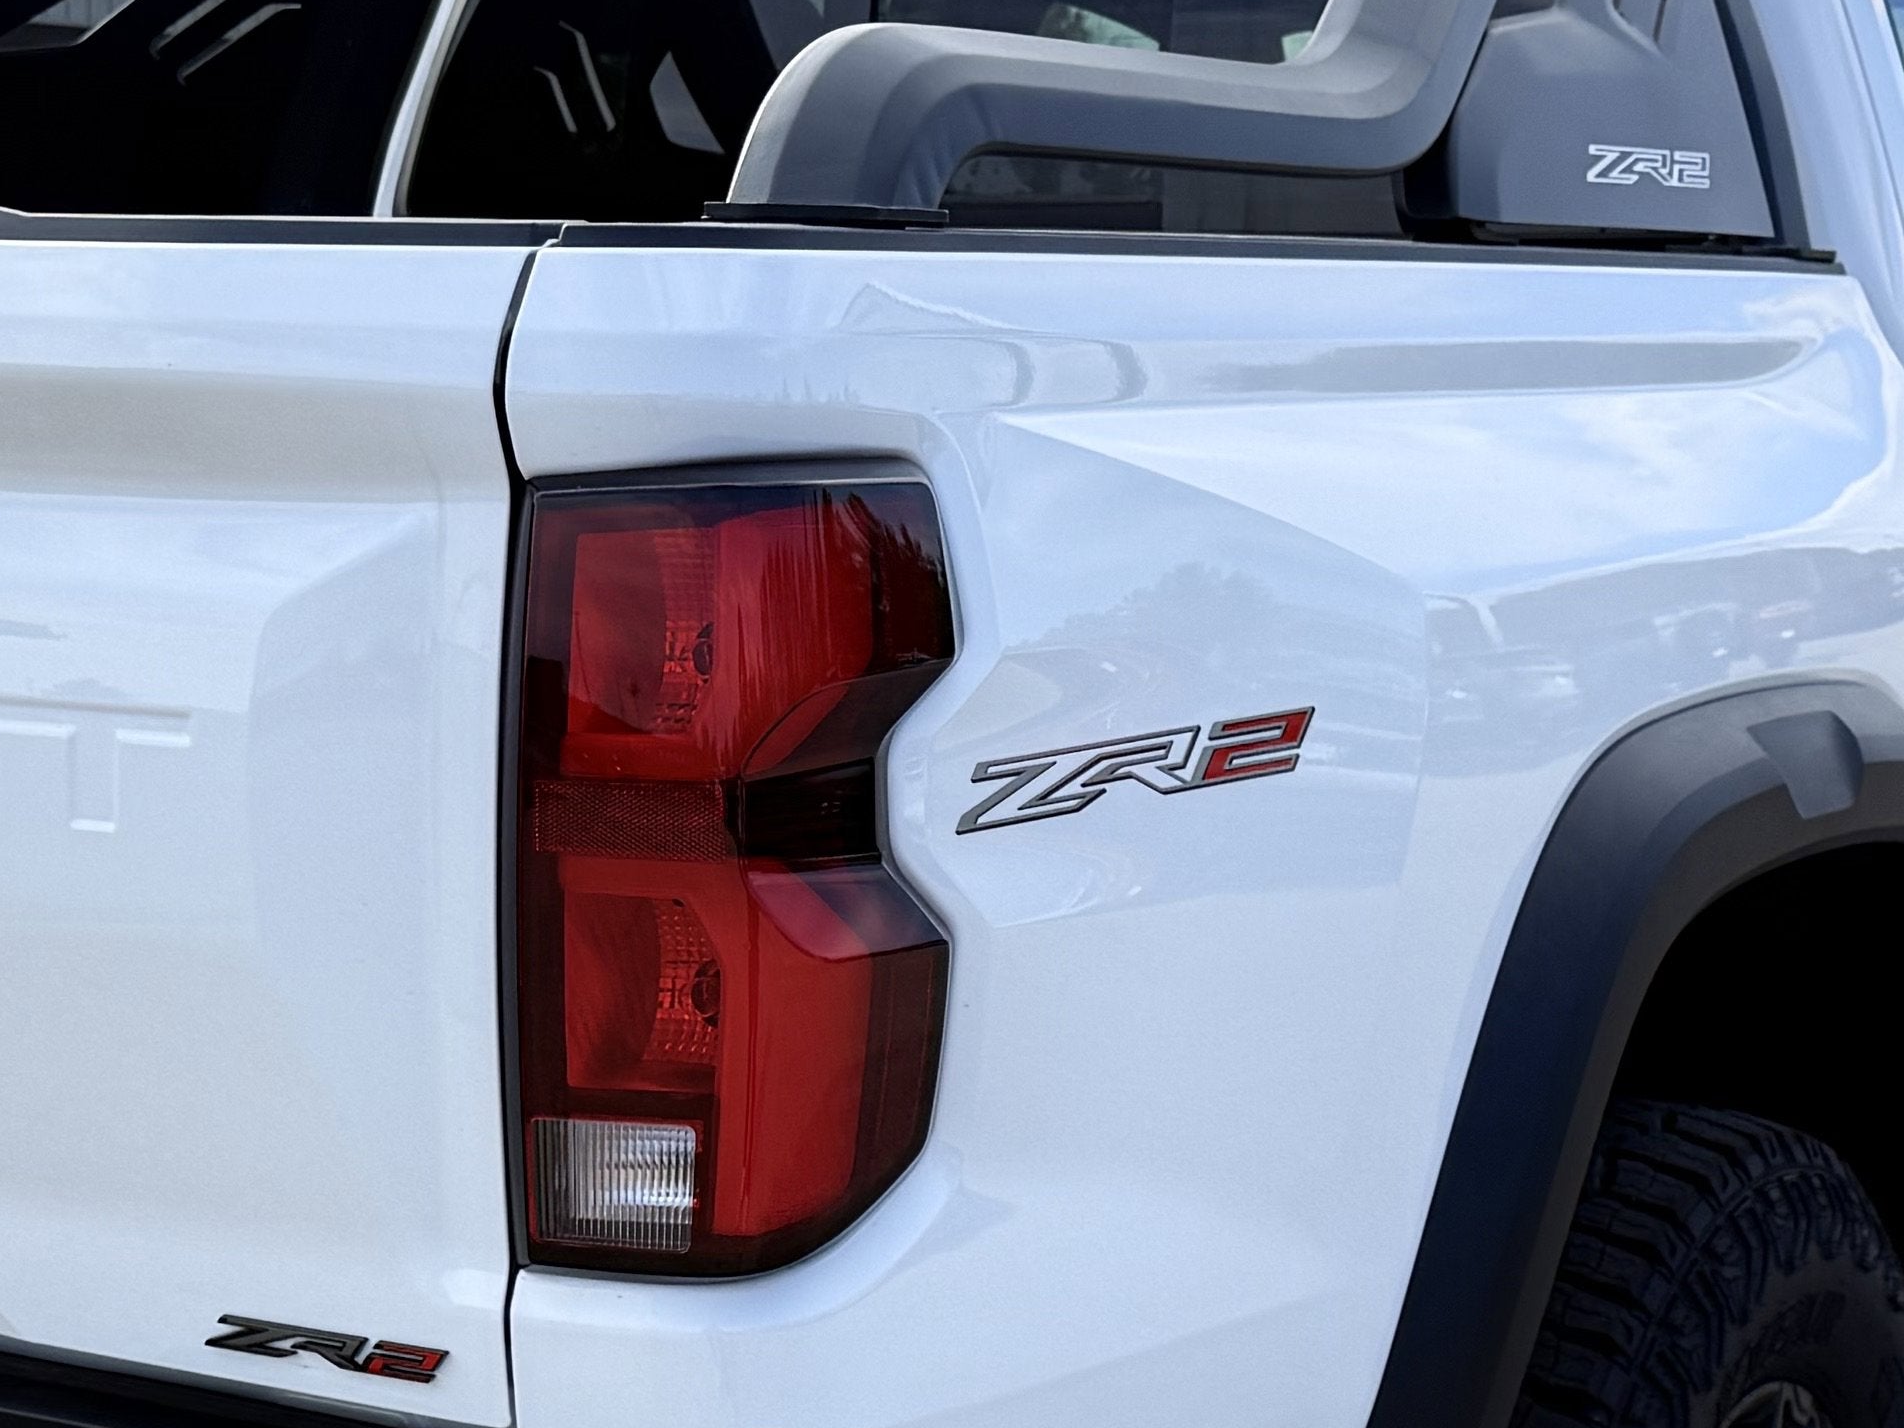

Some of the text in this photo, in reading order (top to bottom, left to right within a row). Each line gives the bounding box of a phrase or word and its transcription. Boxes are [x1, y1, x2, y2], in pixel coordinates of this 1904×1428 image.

[1586, 144, 1710, 188] ZR2
[956, 706, 1315, 835] ZR2
[204, 1314, 449, 1383] ZR2
